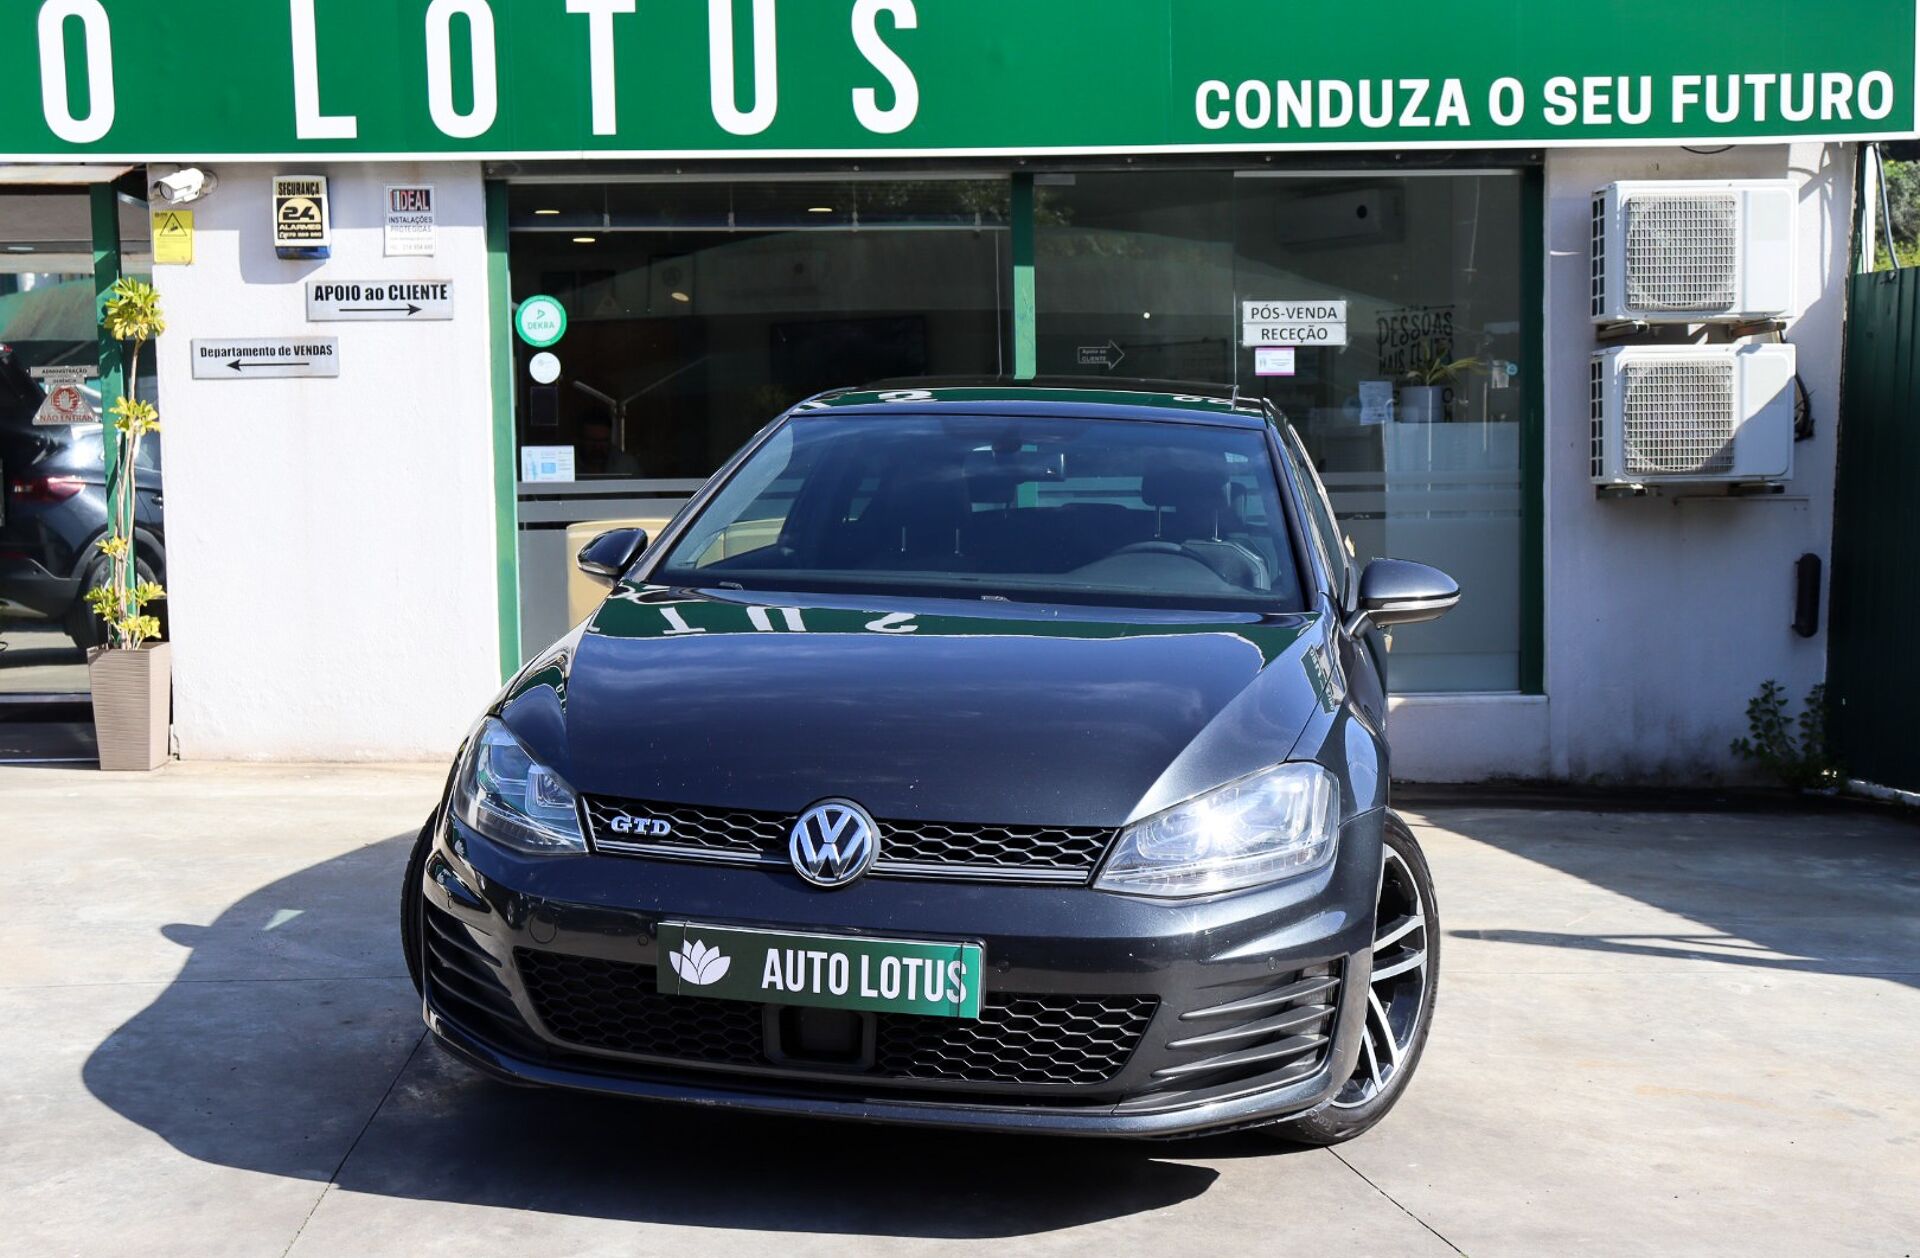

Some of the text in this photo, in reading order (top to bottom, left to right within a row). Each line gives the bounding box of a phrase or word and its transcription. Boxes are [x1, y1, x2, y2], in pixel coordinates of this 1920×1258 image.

[290, 0, 919, 139] LOTUS
[1195, 71, 1894, 129] CONDUZA O SEU FUTURO
[278, 182, 320, 196] SEGURANÇA
[282, 206, 315, 220] 24
[314, 284, 448, 301] APOIO ao CLIENTE
[1250, 304, 1338, 319] PÓS-VENDA
[527, 321, 555, 330] DEKRA
[1261, 325, 1328, 343] RECEÇÃO
[200, 345, 333, 358] Departamento de VENDAS
[611, 815, 672, 836] GTD
[761, 948, 967, 1004] AUTO LOTUS
